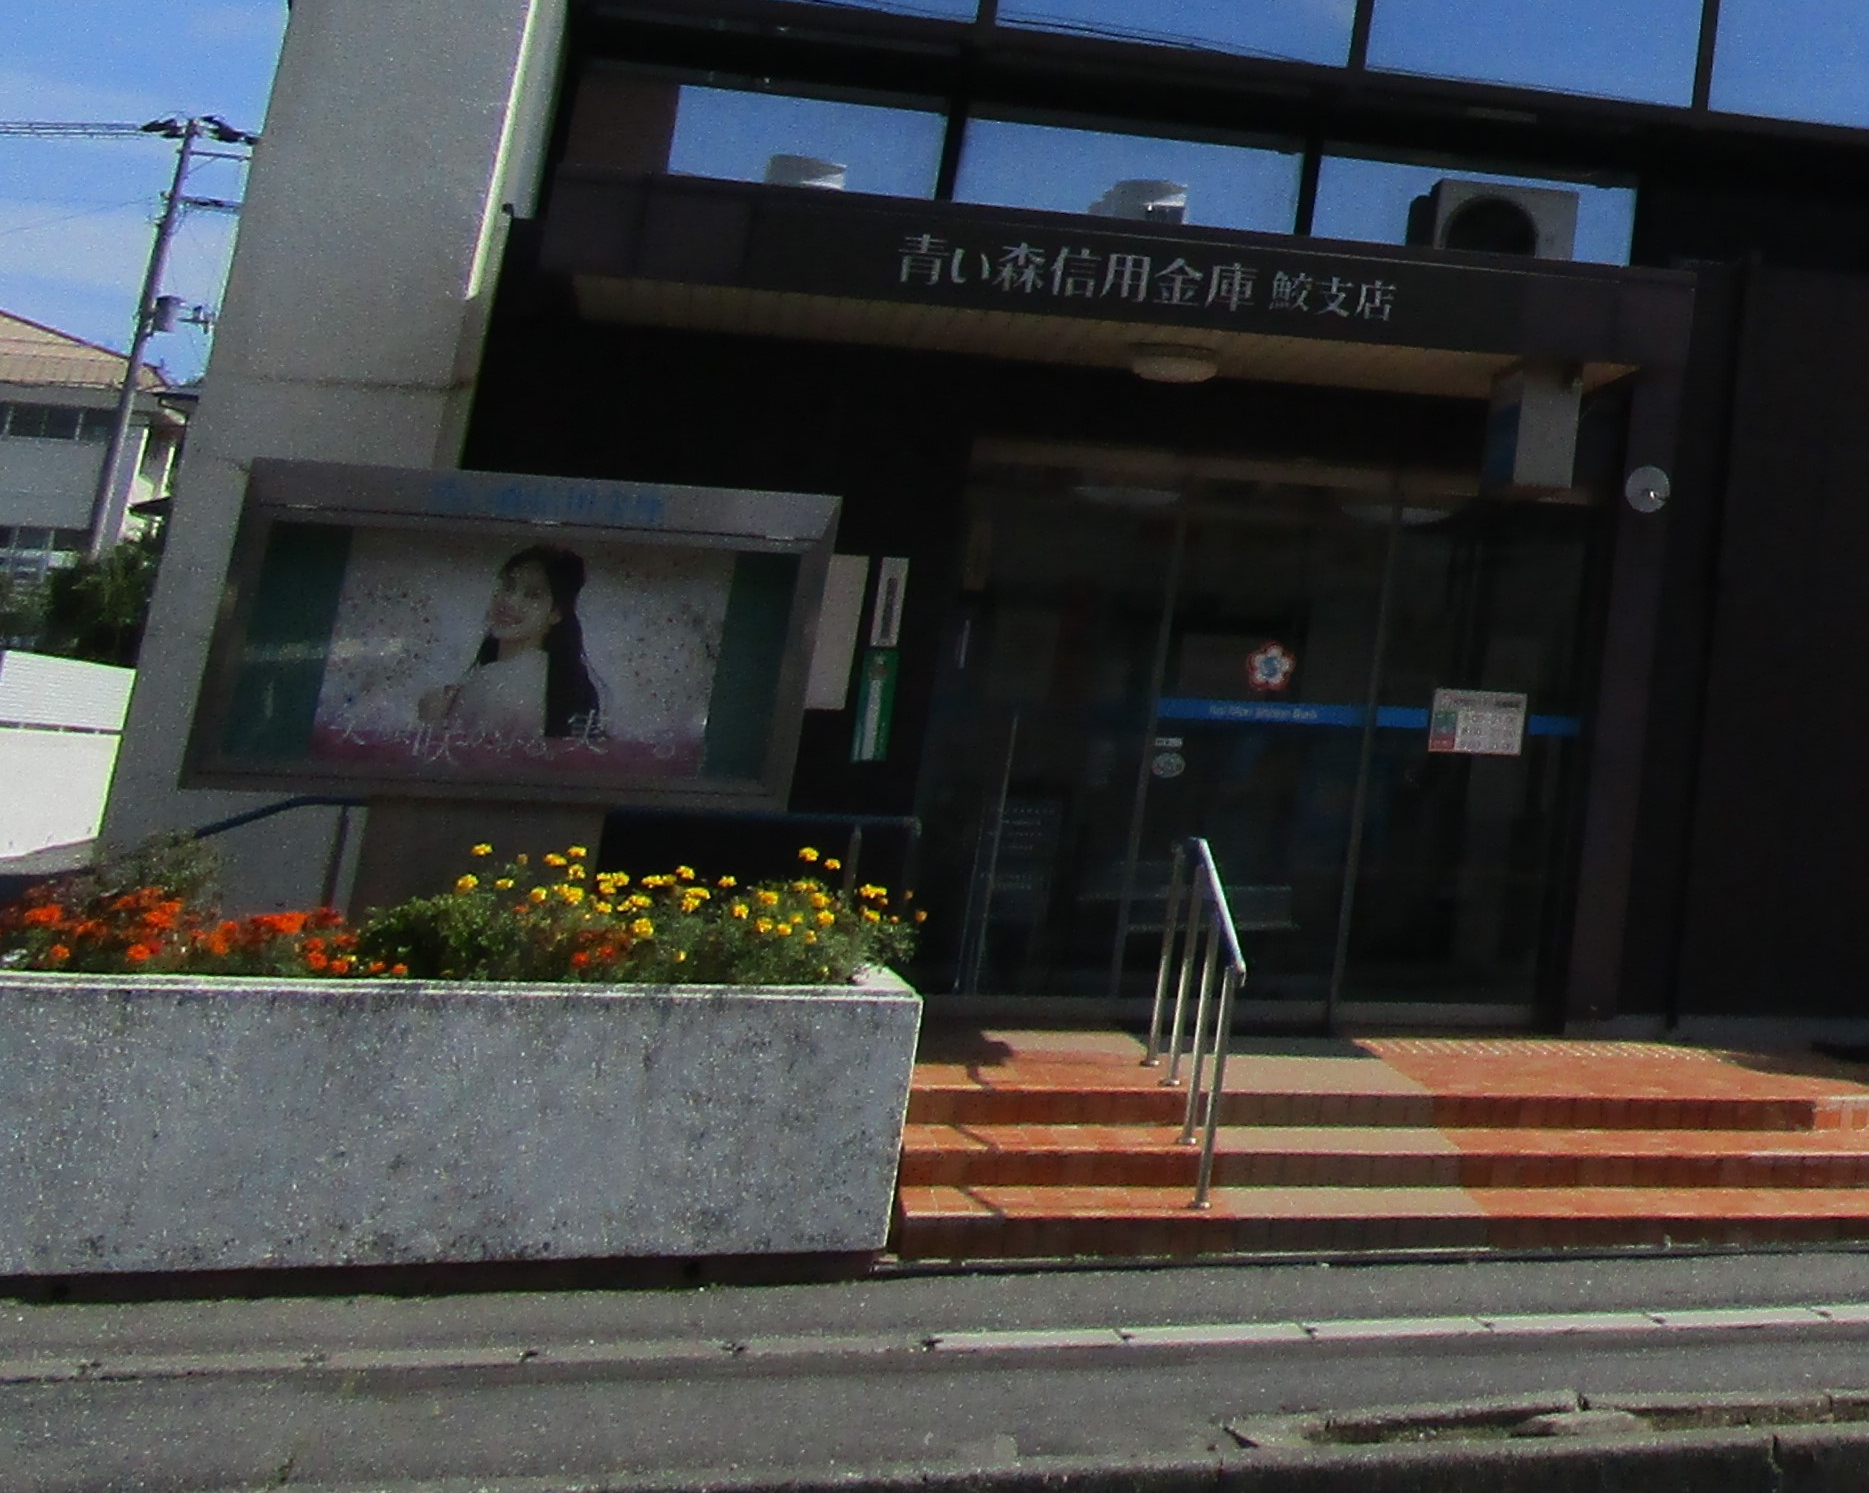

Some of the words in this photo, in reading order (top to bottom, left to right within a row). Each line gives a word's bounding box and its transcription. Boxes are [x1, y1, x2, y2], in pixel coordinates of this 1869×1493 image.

[899, 233, 1257, 312] 青い森信用金庫
[1269, 270, 1396, 321] 鮫支店
